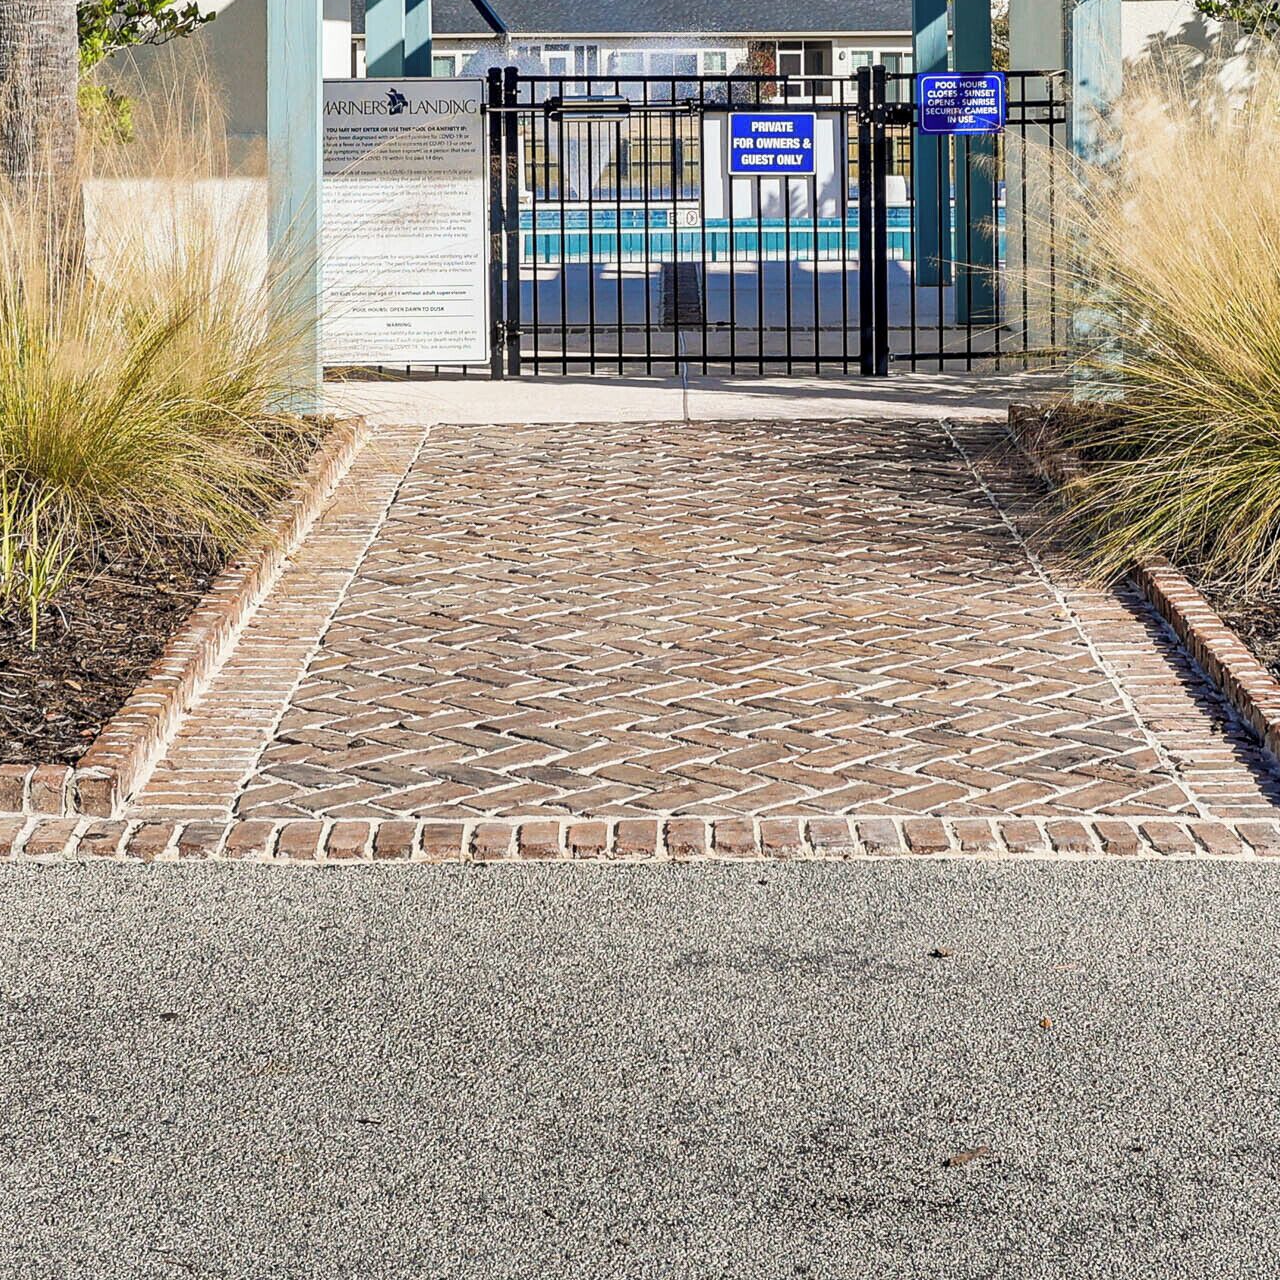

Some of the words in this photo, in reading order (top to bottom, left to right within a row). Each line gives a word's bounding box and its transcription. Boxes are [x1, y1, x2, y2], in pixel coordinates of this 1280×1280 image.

[935, 81, 957, 89] POOL
[959, 80, 988, 89] HOURS
[927, 90, 958, 98] CLOSES
[964, 89, 996, 97] SUNSET
[409, 99, 477, 114] LANDING
[927, 98, 955, 106] OPENS
[962, 98, 996, 106] SUNRISE
[925, 107, 962, 115] SECURITY
[964, 106, 998, 115] CAMERS
[947, 115, 956, 123] IN
[958, 115, 976, 123] USE.
[751, 121, 794, 132] PRIVATE
[733, 137, 754, 149] FOR
[756, 137, 800, 149] OWNERS
[802, 138, 812, 149] &
[741, 154, 775, 165] GUEST
[776, 154, 803, 165] ONLY
